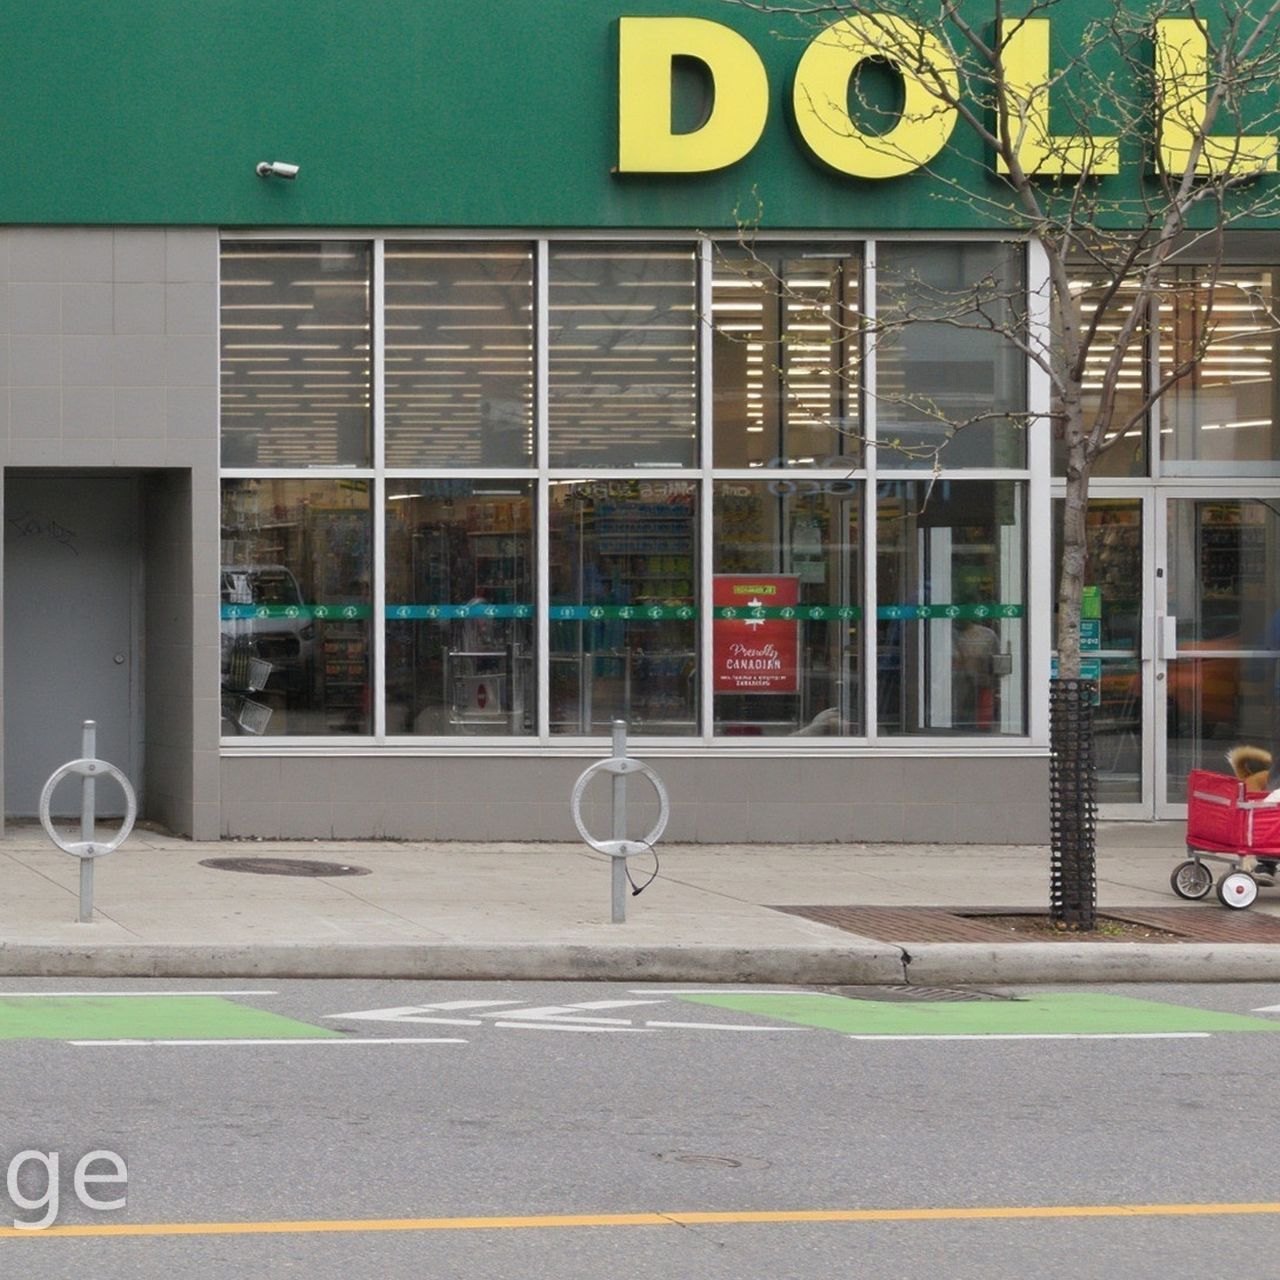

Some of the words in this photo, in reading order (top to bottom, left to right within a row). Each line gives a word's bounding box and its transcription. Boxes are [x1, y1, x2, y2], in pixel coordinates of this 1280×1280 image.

[618, 13, 1278, 179] DOLL
[729, 643, 779, 660] Proudly
[726, 659, 782, 670] CANADIAN
